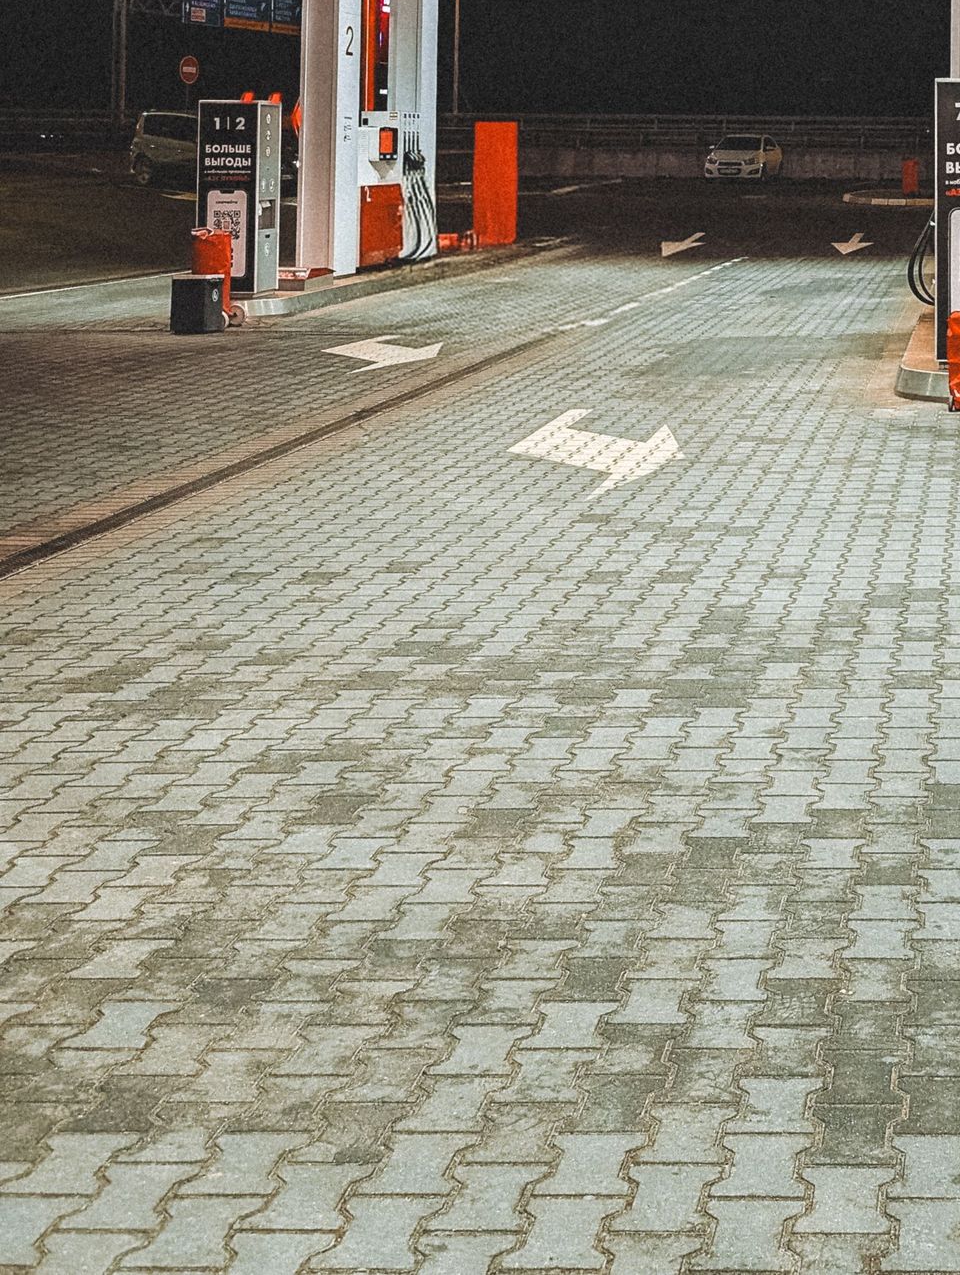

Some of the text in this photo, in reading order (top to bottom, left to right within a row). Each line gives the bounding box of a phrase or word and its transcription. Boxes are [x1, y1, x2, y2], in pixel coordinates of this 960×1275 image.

[345, 26, 354, 56] 2
[205, 144, 252, 154] БОЛЬШЕ
[204, 157, 251, 168] ВЫГОДЫ
[364, 186, 372, 202] 2
